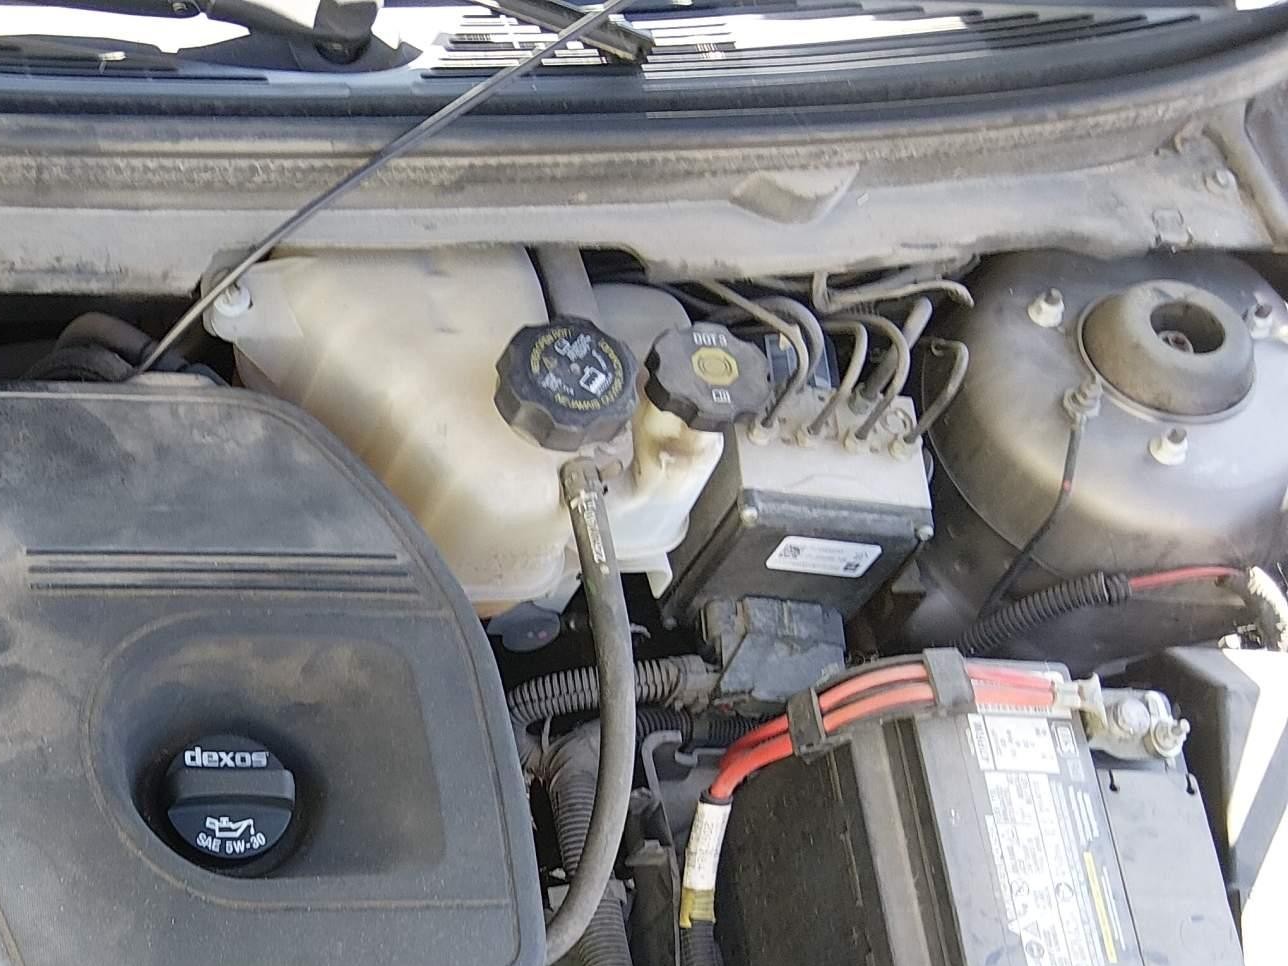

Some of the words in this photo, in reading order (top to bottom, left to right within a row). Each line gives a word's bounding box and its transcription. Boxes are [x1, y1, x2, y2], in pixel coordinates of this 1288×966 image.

[184, 746, 269, 768] dexos
[196, 832, 221, 853] SAE
[225, 834, 266, 854] 5W-30
